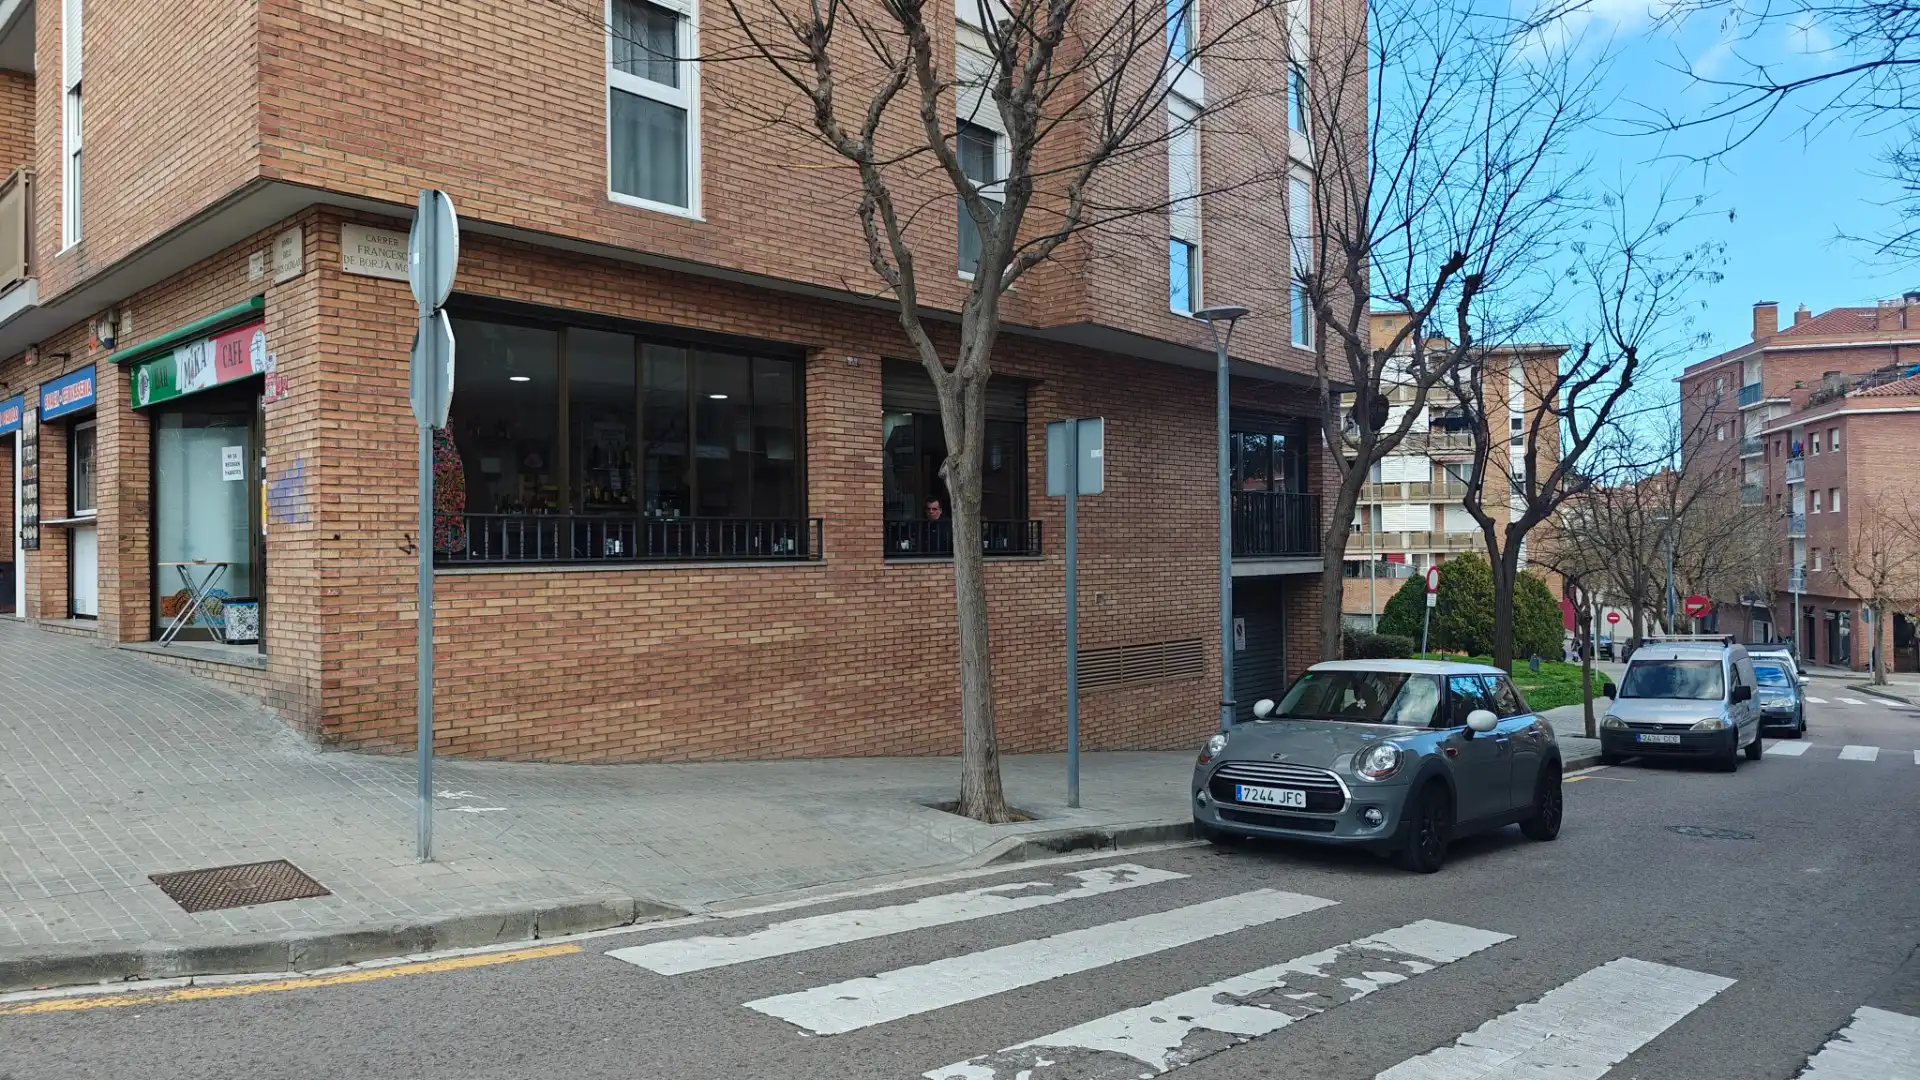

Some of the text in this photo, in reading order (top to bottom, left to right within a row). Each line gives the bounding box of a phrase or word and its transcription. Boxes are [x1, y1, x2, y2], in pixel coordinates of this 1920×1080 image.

[365, 234, 399, 247] CARRER
[357, 245, 408, 261] FRANCESC
[344, 255, 356, 265] DE
[359, 257, 393, 271] BORJA
[1244, 788, 1302, 805] 7244 JFC
